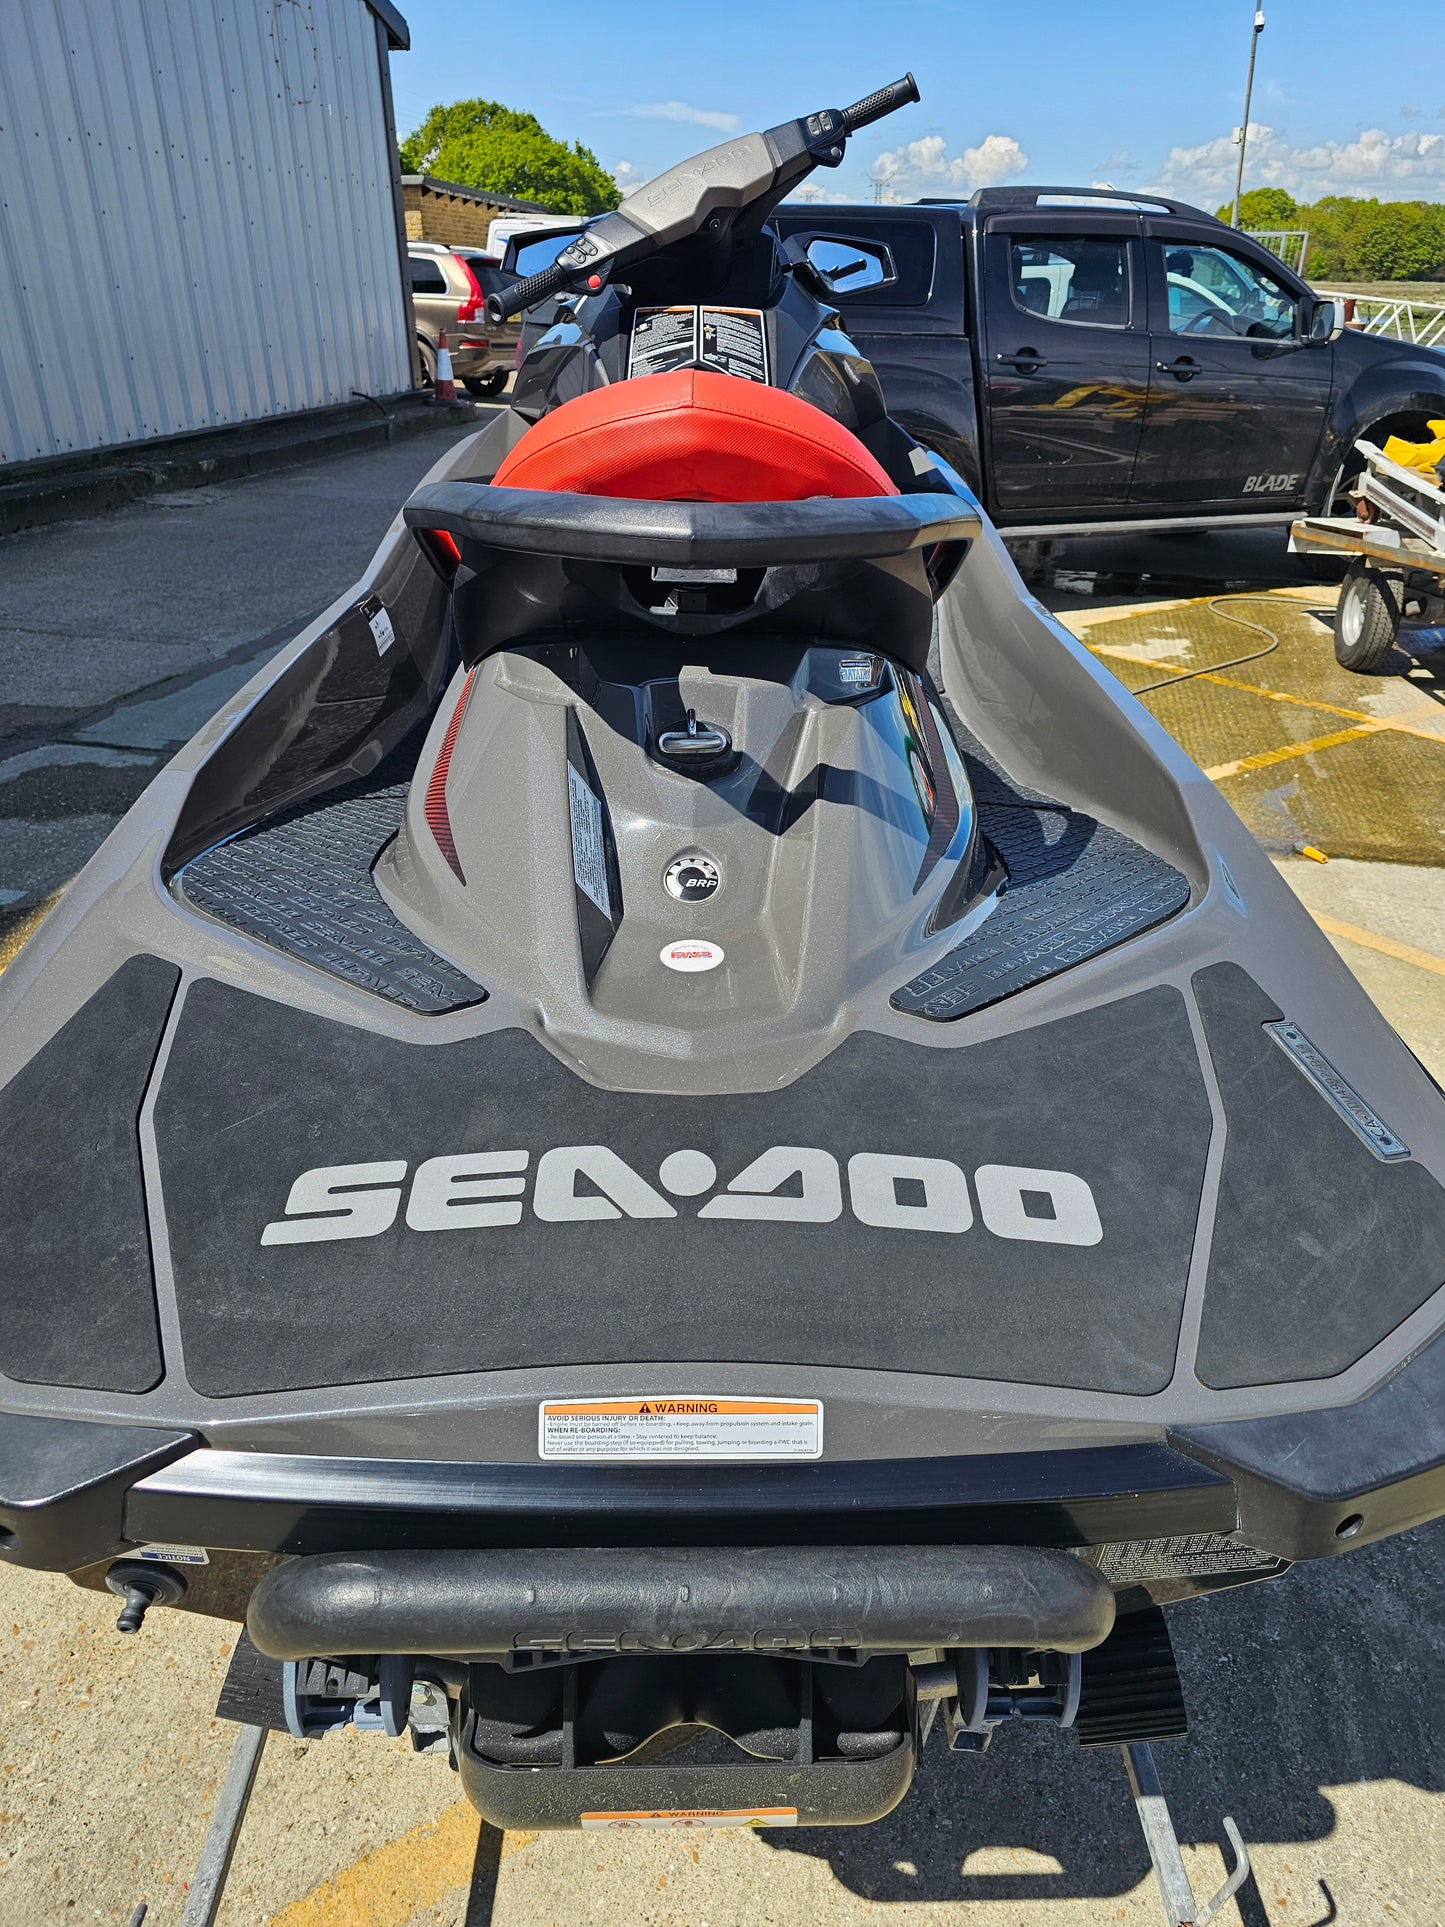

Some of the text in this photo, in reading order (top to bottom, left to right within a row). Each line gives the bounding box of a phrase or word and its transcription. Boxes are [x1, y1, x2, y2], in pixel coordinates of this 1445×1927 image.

[1242, 474, 1299, 493] BLADE
[686, 878, 717, 888] BRP
[656, 1403, 718, 1413] WARNING
